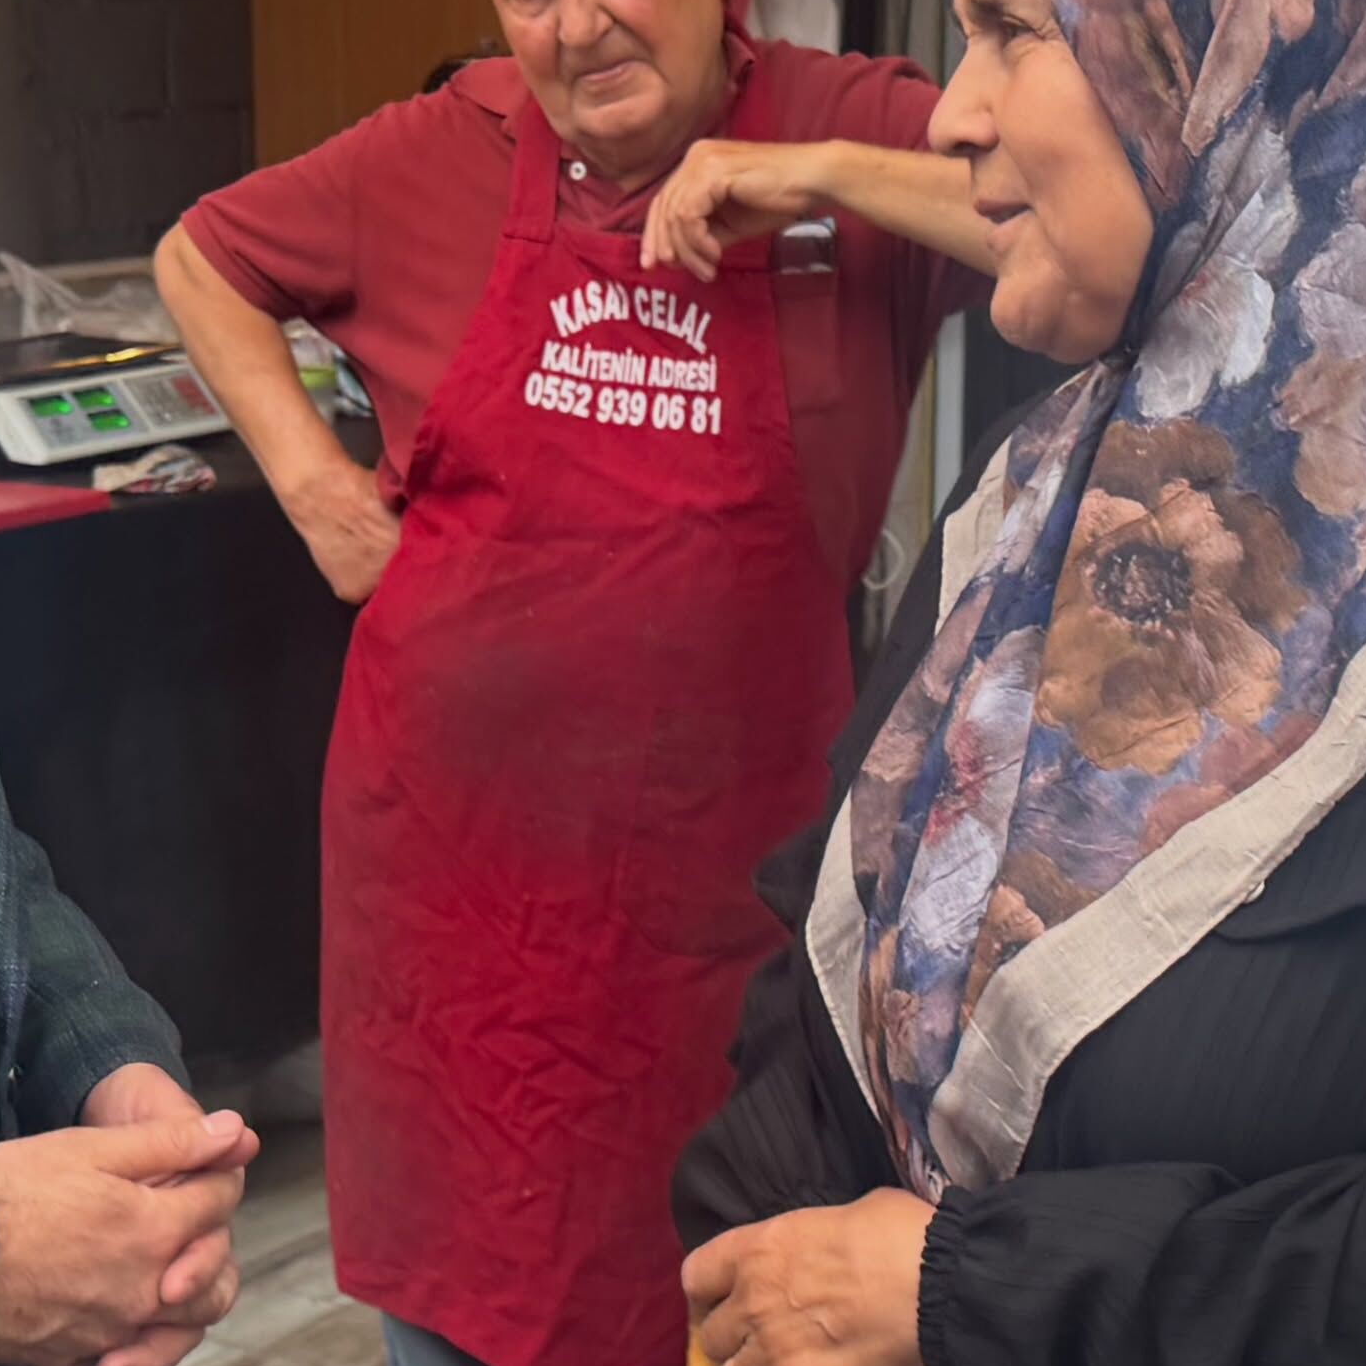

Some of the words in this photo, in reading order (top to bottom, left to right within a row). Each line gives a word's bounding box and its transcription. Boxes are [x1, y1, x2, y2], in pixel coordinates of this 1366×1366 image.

[634, 286, 712, 354] CELAL
[541, 340, 647, 386] KALİTENİN
[648, 353, 717, 393] ADRESİ
[524, 372, 593, 418] 0552
[596, 387, 648, 427] 939
[652, 393, 687, 431] 06
[691, 397, 722, 435] 81
